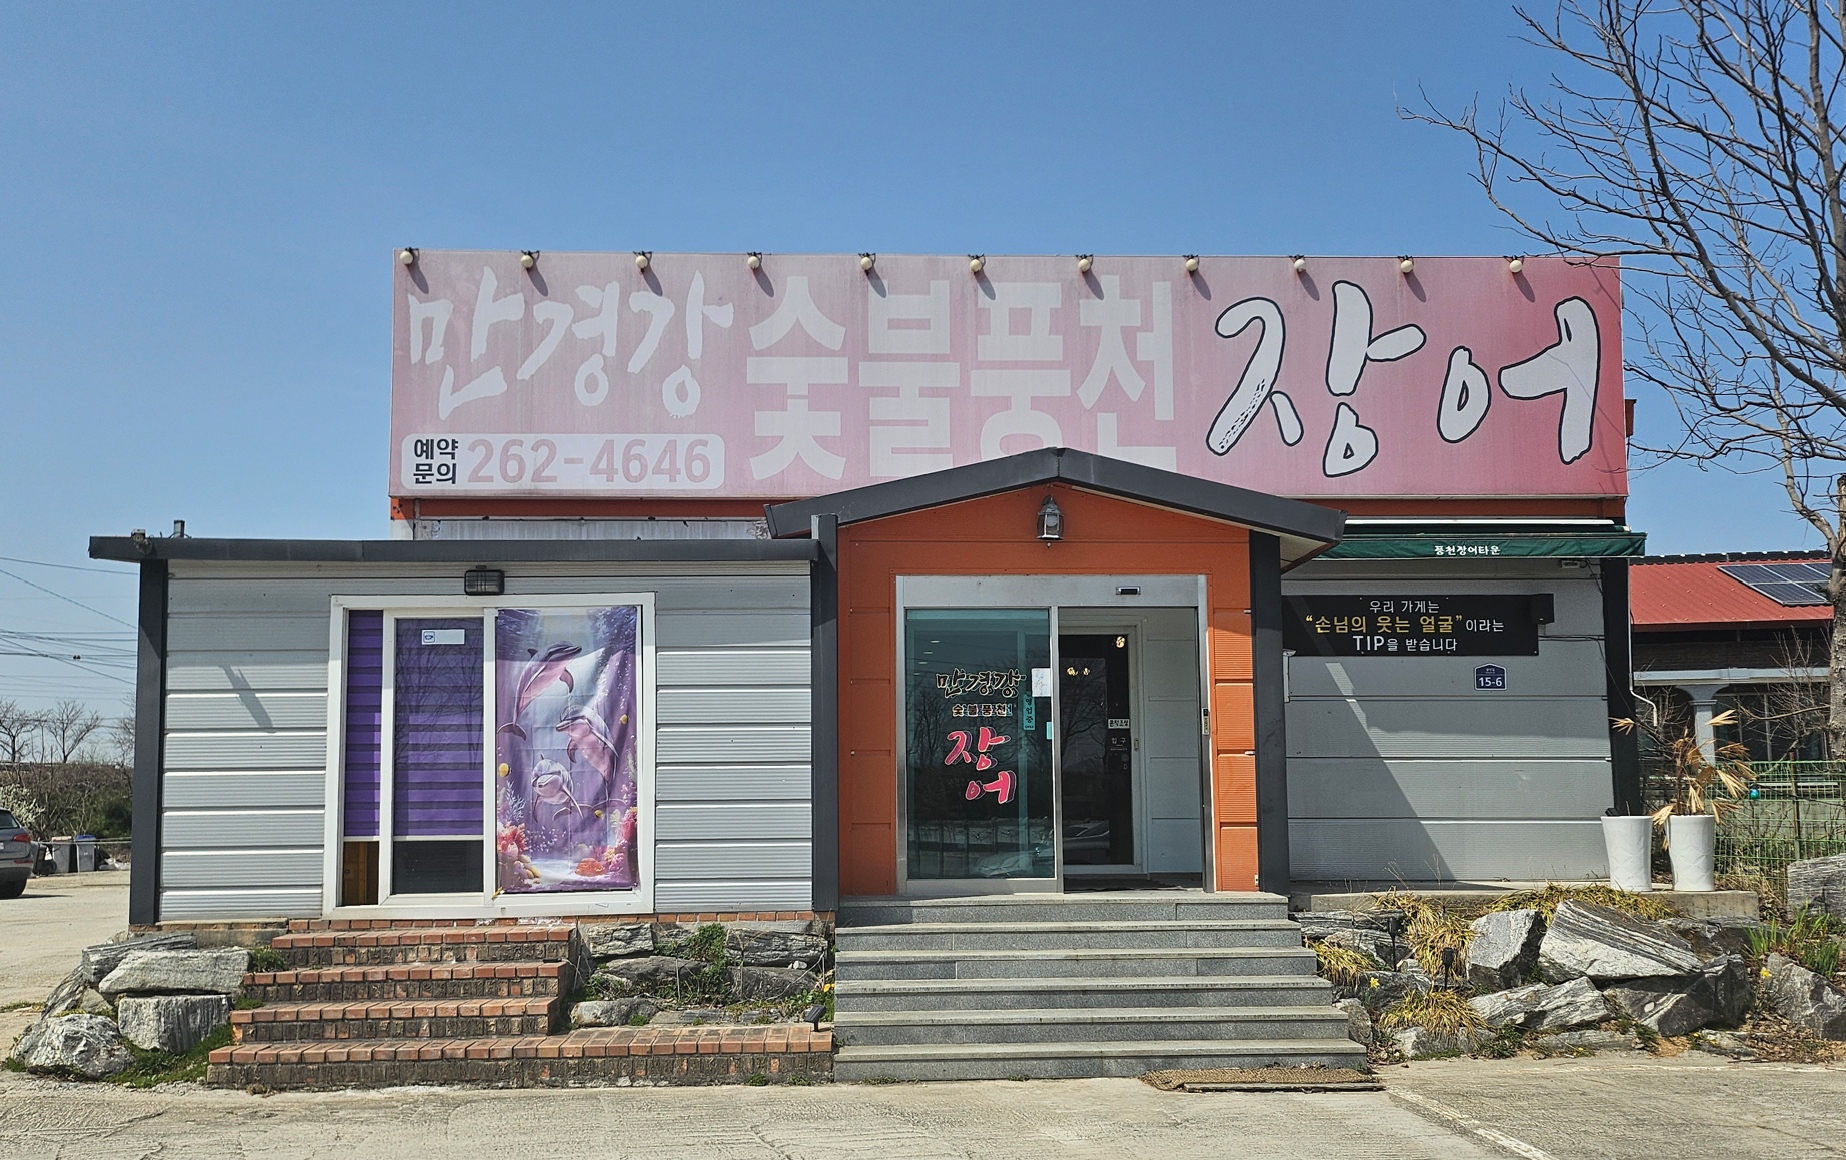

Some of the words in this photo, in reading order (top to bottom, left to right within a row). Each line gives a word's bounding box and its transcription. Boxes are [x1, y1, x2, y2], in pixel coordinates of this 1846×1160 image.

[406, 266, 735, 421] 만경강
[746, 275, 1177, 481] 숯불풍천
[1206, 280, 1600, 477] 장어
[413, 438, 459, 460] 예약
[466, 438, 712, 484] 262-4646
[413, 462, 457, 485] 문의
[1434, 545, 1501, 556] 풍천장어타운
[1369, 600, 1395, 614] 우리
[1400, 600, 1440, 614] 가게는
[1376, 615, 1411, 634] 웃는
[1405, 638, 1458, 652] 받습니다
[936, 667, 1023, 699] 만경강
[1478, 676, 1503, 687] 15-6
[952, 703, 1008, 717] 숯불풍천
